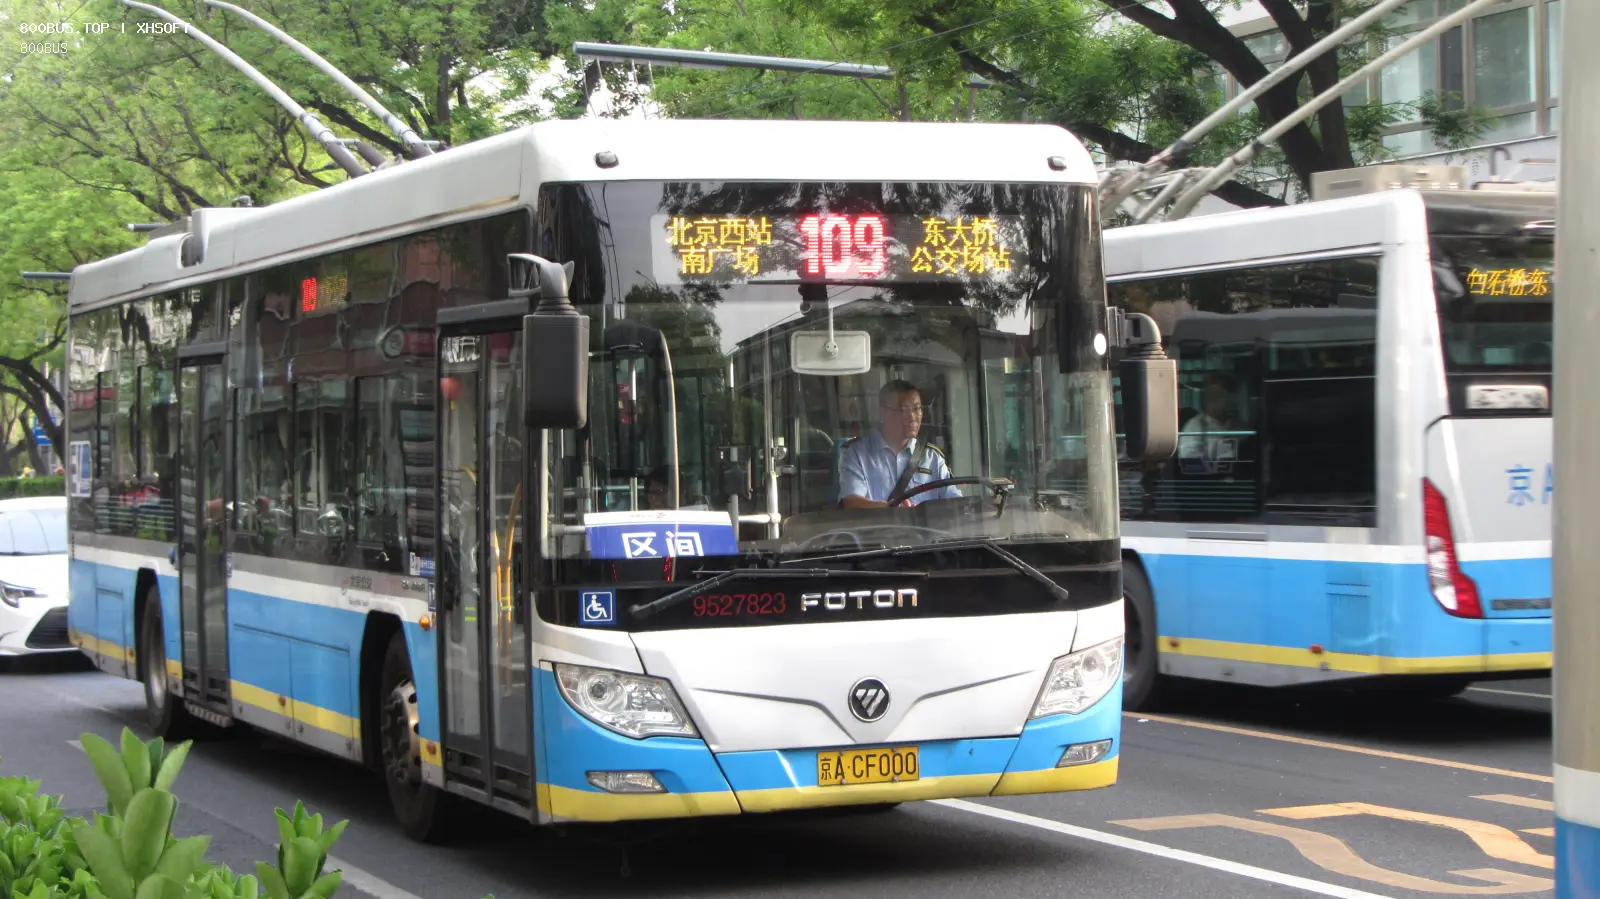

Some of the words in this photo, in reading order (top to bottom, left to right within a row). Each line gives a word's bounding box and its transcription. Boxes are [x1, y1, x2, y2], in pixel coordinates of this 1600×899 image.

[666, 216, 772, 245] 北京西站
[800, 215, 884, 273] 109
[922, 217, 998, 246] 东大桥
[679, 245, 760, 275] 南广场
[911, 246, 1011, 274] 公交场站
[1467, 268, 1550, 296] 白石桥东
[622, 531, 704, 558] 区间
[692, 592, 786, 617] 9527823
[801, 589, 918, 611] FOTON
